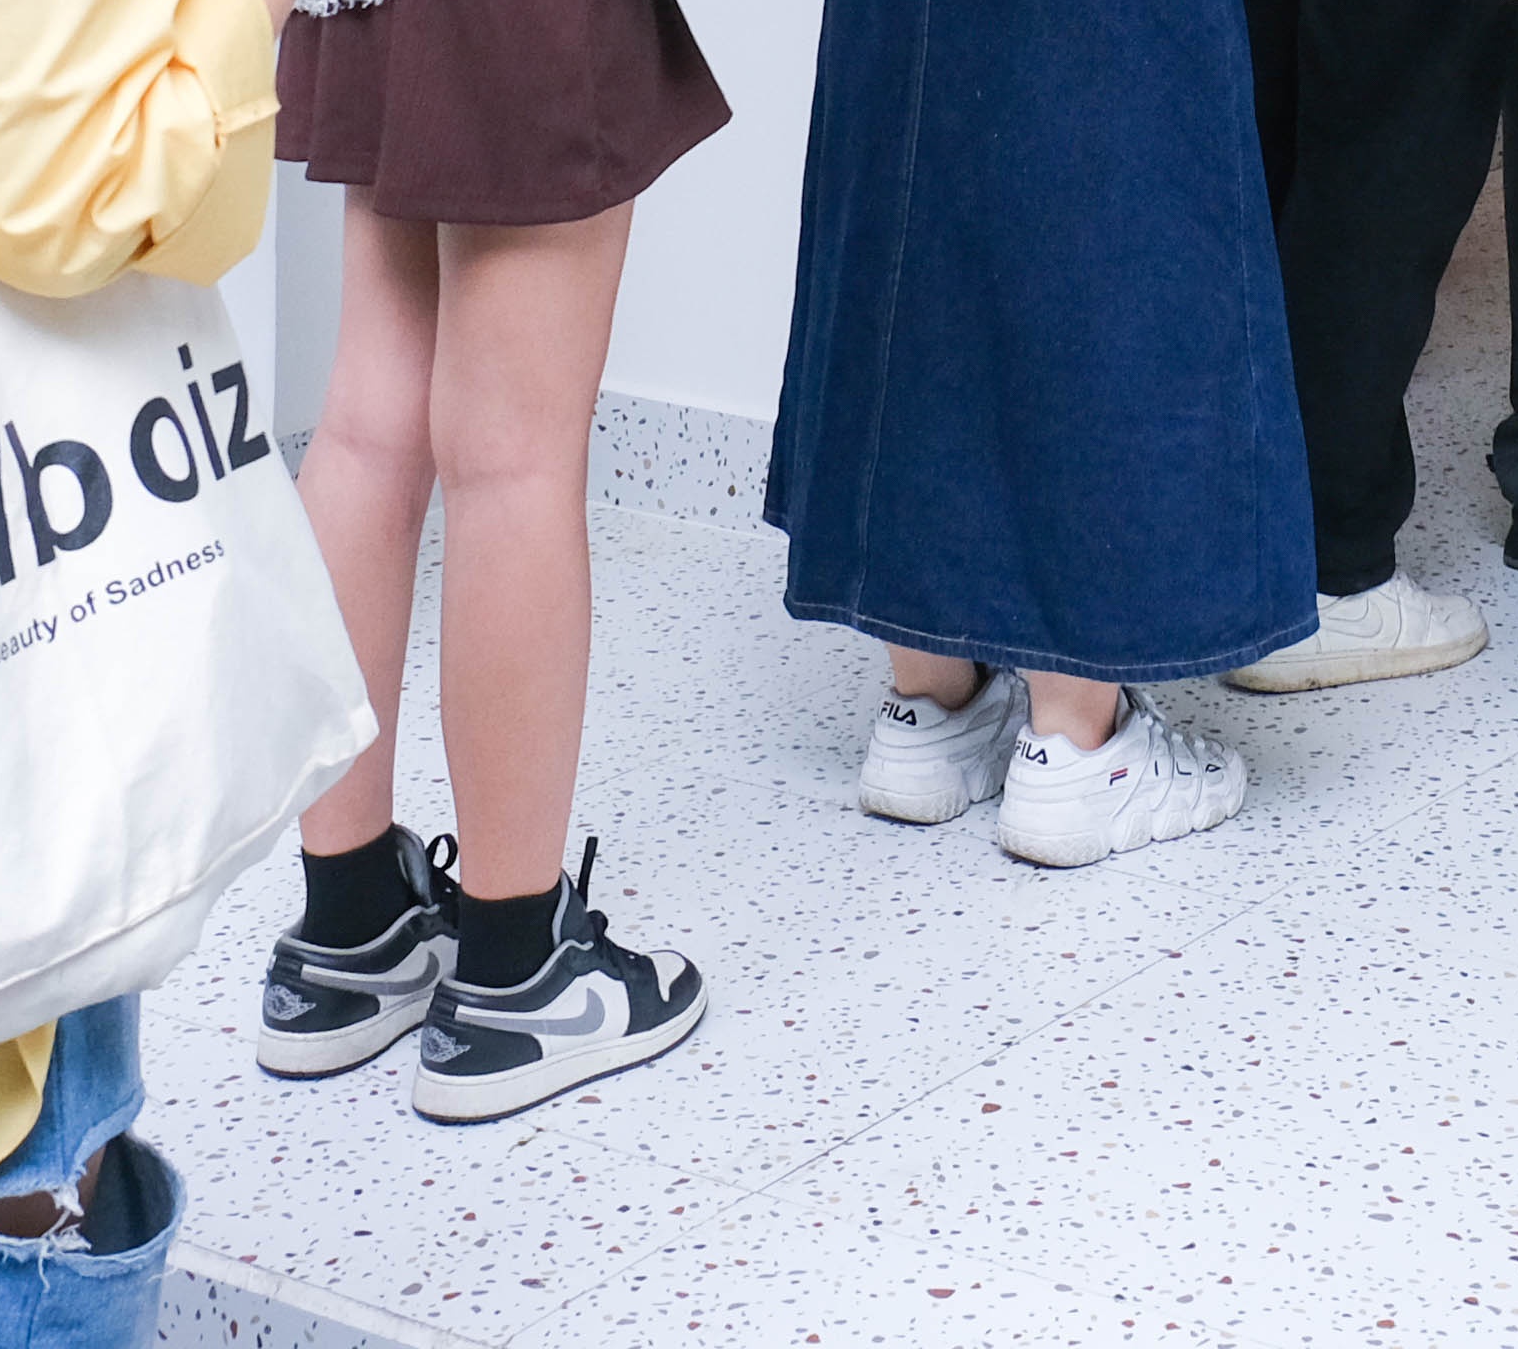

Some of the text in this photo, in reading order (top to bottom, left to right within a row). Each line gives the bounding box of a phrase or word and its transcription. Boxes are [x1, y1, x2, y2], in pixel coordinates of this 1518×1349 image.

[68, 591, 100, 625] of
[104, 537, 227, 607] Sadness
[880, 701, 918, 727] FILA
[1013, 739, 1049, 766] FILA
